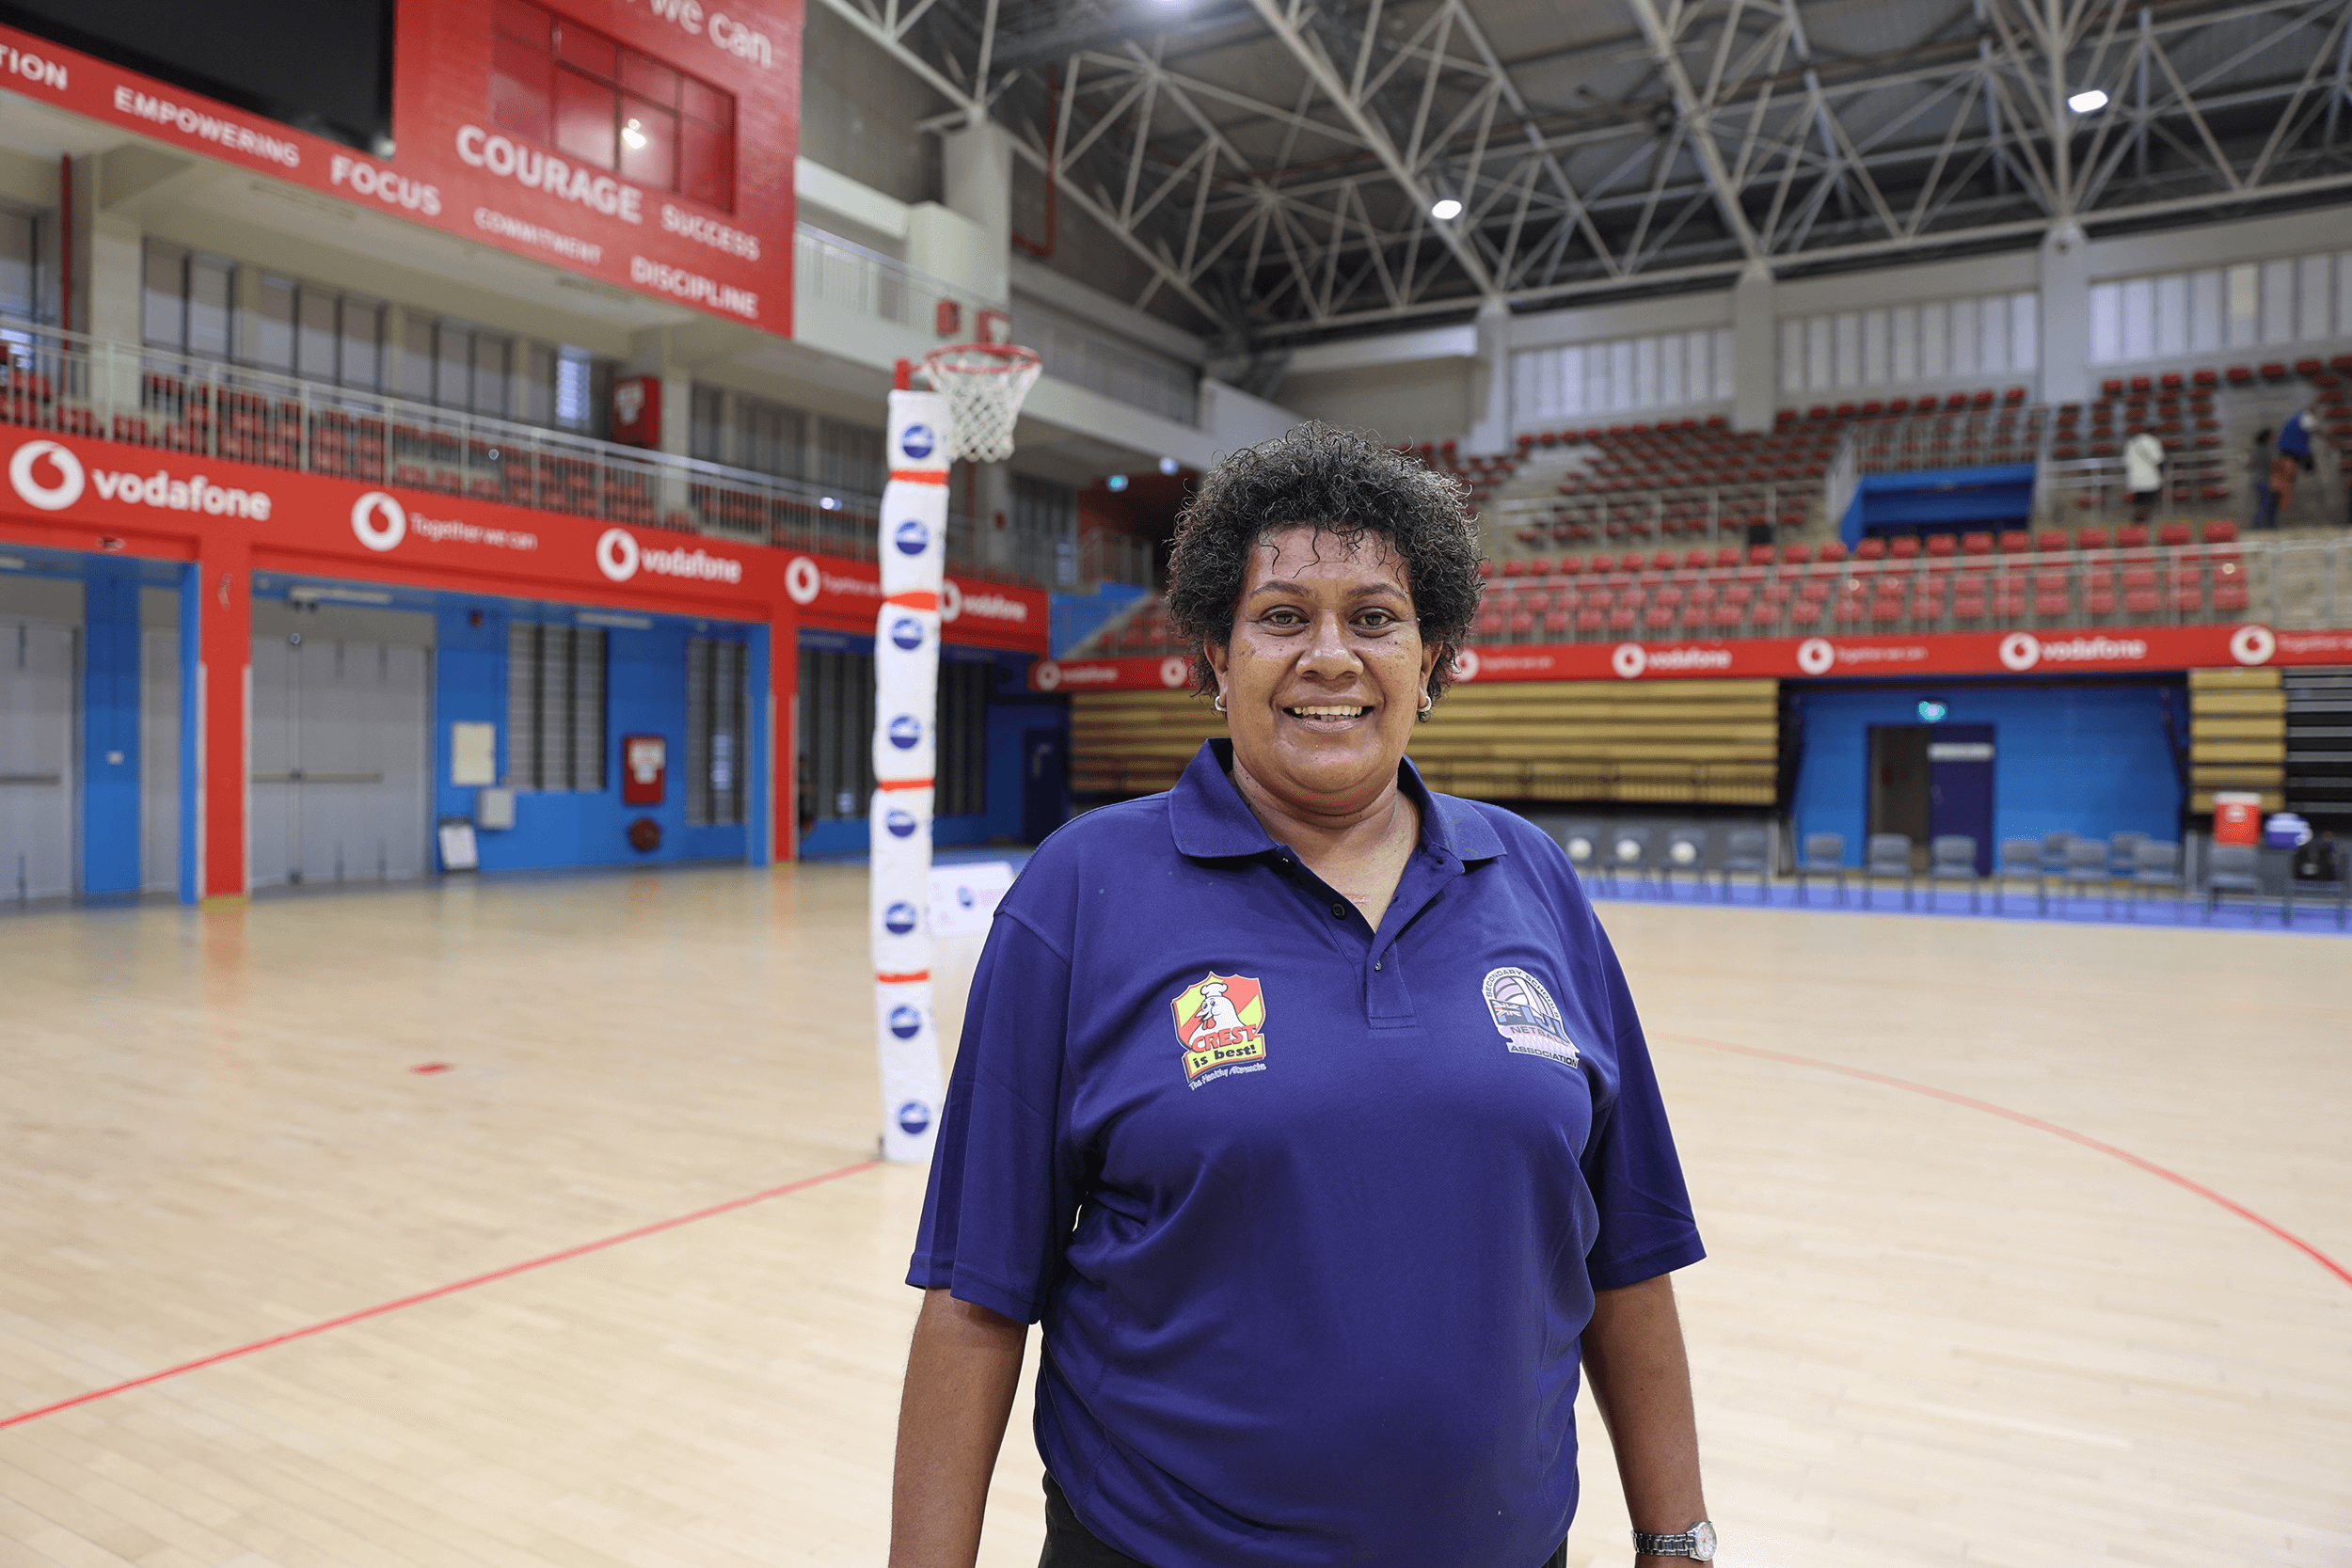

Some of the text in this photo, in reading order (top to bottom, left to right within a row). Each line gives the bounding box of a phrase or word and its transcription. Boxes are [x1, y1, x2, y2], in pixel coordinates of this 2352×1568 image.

[707, 12, 771, 69] can
[114, 85, 300, 167] EMPOWERING
[330, 153, 441, 216] FOCUS
[455, 124, 644, 225] COURAGE
[473, 207, 603, 264] COMMITMENT
[660, 204, 760, 261] SUCCESS
[630, 256, 759, 320] DISCIPLINE
[92, 468, 271, 521] vodafone
[642, 546, 743, 584] vodafone
[2042, 635, 2148, 661] vodafone
[1486, 969, 1560, 1018] SECONDARY SCHOOLS
[1191, 1023, 1257, 1053] CREST
[1193, 1044, 1257, 1068] is best!
[1510, 1026, 1569, 1047] NETBALL
[1510, 1045, 1577, 1068] ASSOCIATION
